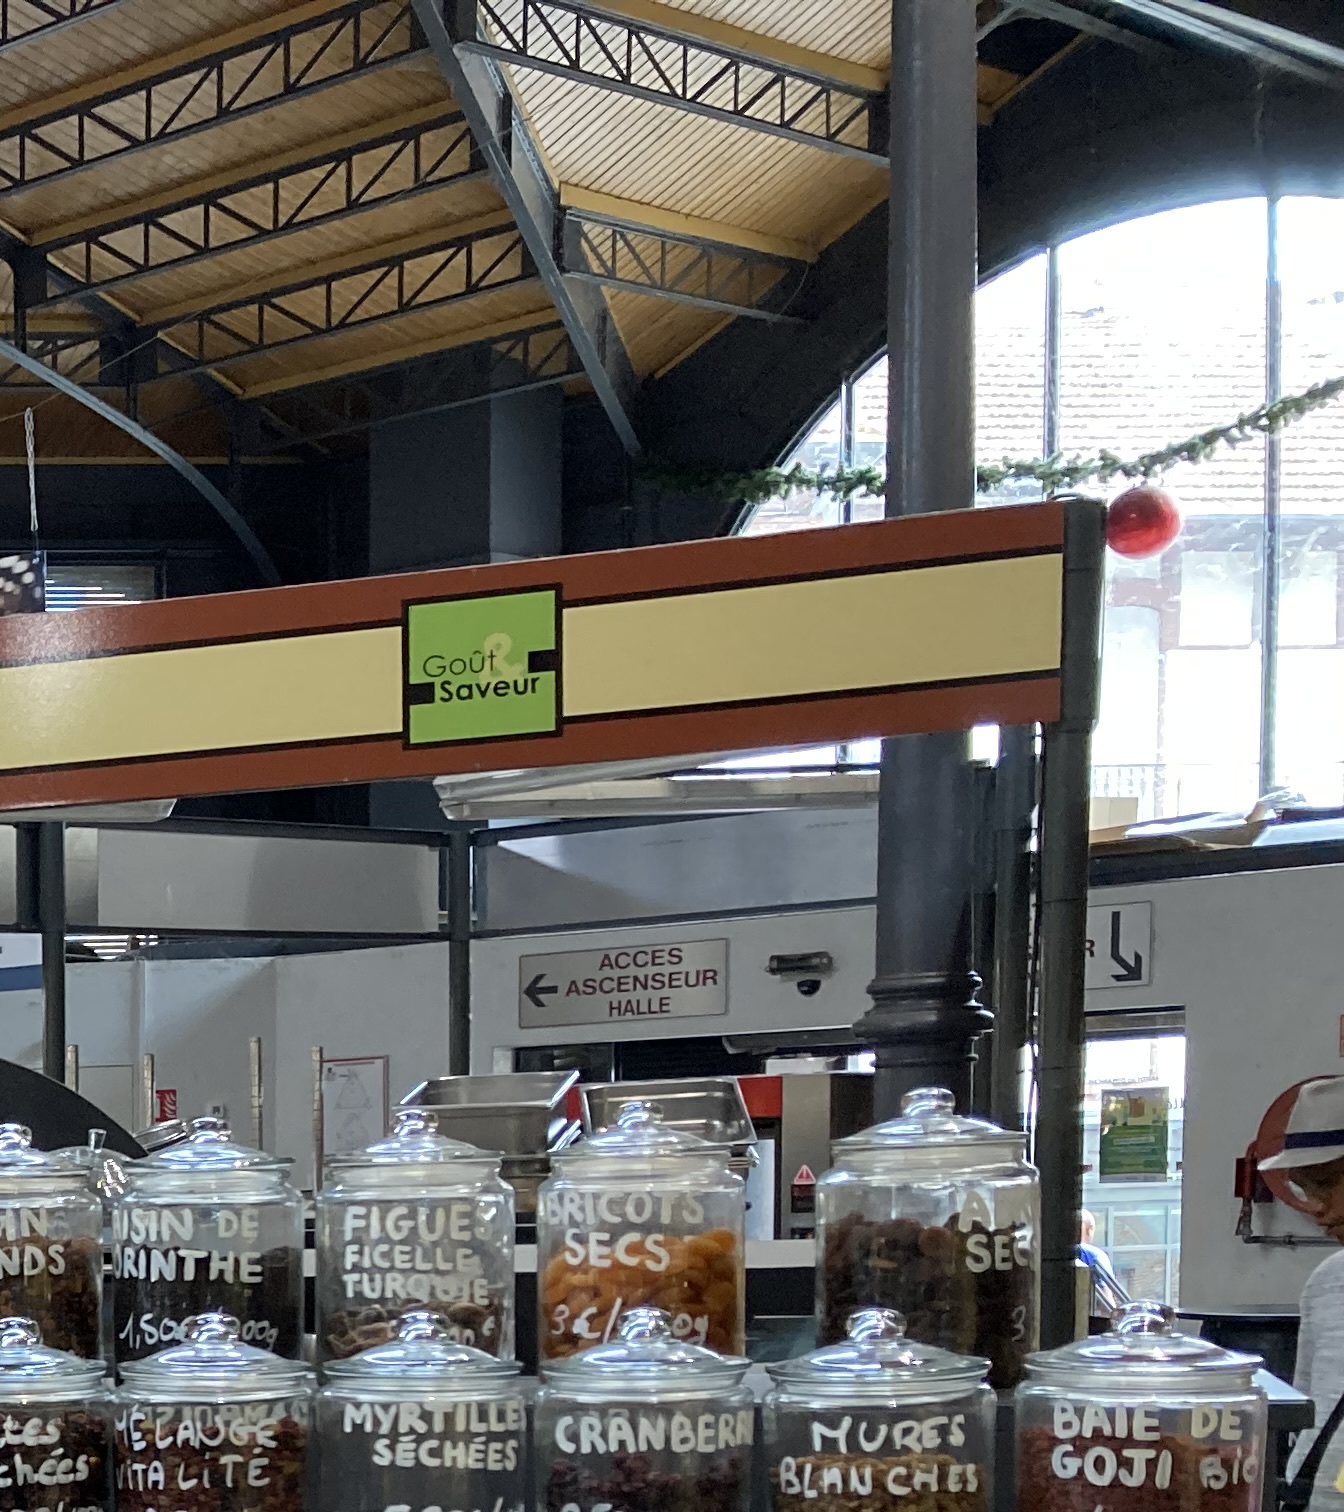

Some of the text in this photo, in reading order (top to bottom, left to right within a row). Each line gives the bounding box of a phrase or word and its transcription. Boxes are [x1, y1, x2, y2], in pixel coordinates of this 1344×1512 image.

[423, 650, 496, 677] Goût
[440, 677, 540, 702] Saveur
[598, 948, 683, 971] ACCES
[566, 969, 718, 997] ASCENSEUR
[609, 997, 671, 1017] HALLE
[218, 1206, 261, 1239] DE
[343, 1205, 493, 1244] FIGUES
[539, 1191, 704, 1225] BRICOTS
[343, 1244, 481, 1274] FICELLE
[564, 1228, 670, 1272] SECS
[812, 1415, 966, 1453] MURES
[1052, 1402, 1243, 1441] BAIE DE
[372, 1437, 518, 1471] SÉCHÉES
[1051, 1447, 1173, 1491] GOJI
[778, 1457, 979, 1501] BLANCHES
